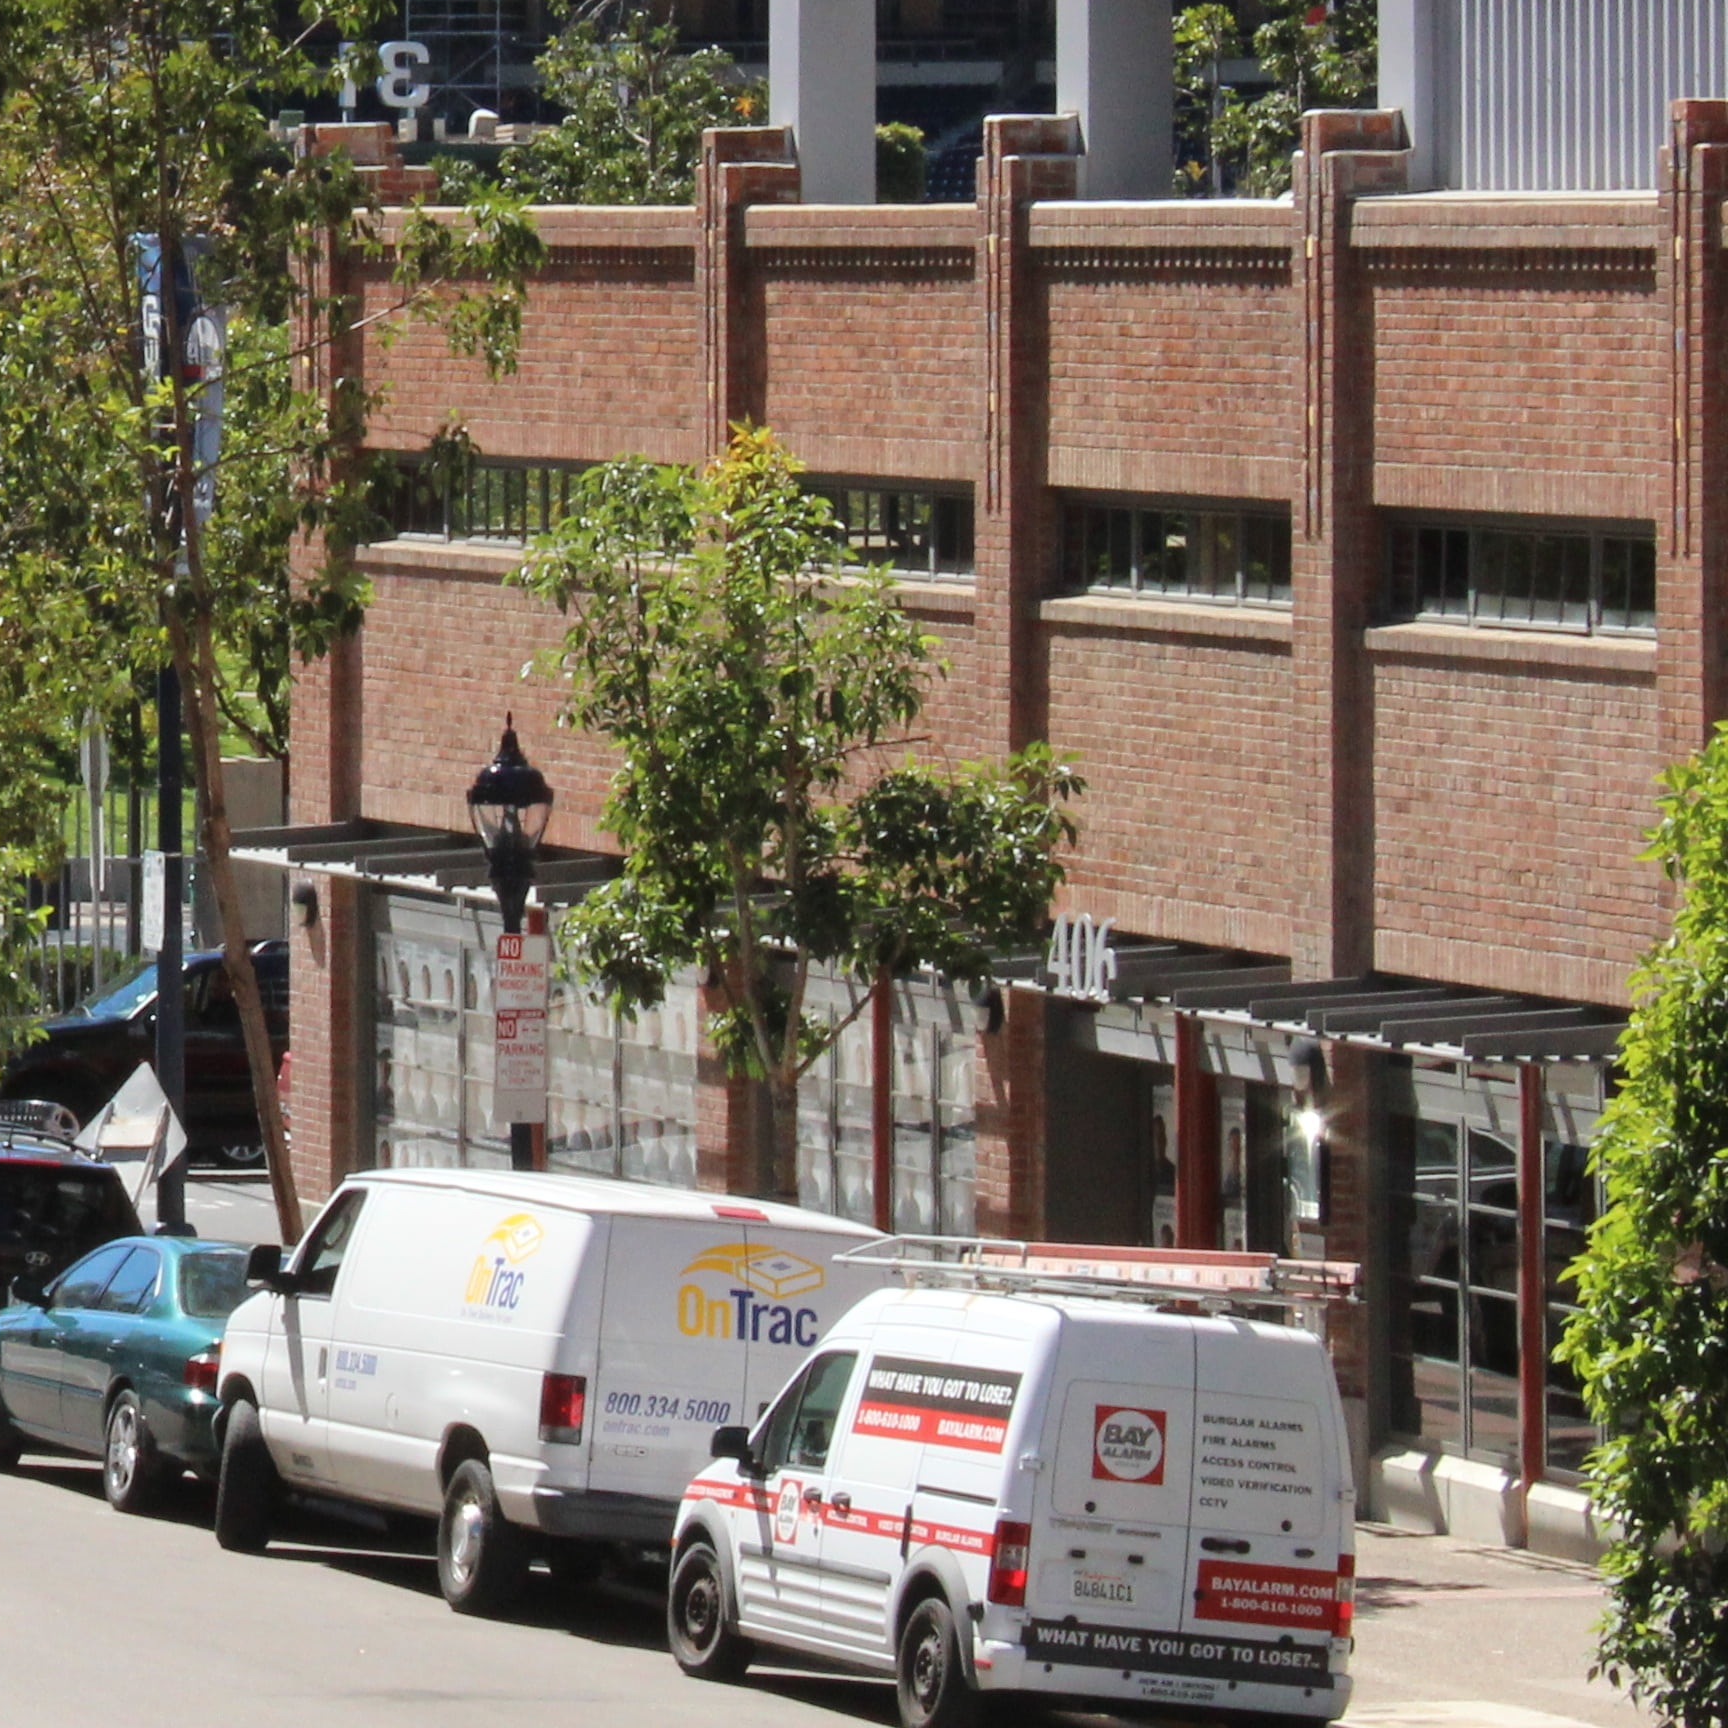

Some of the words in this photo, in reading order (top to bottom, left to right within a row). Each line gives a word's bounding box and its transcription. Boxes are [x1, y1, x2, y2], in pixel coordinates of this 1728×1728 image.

[499, 937, 520, 958] NO
[1047, 912, 1118, 1004] 406
[499, 962, 544, 978] PARKING
[497, 1019, 515, 1038] NO
[497, 1042, 544, 1056] PARKING
[465, 1254, 524, 1309] OnTrac
[677, 1284, 818, 1347] OnTrac
[868, 1370, 896, 1389] WHAT
[895, 1372, 923, 1393] HAVE
[922, 1376, 945, 1396] YOU
[943, 1379, 966, 1400] GOT
[965, 1381, 980, 1402] TO
[604, 1392, 731, 1424] 800.334.5000
[858, 1410, 921, 1432] 1-800-610-1000
[936, 1419, 1005, 1444] BAYALARM.COM
[1202, 1415, 1255, 1428] BURGLAR
[1258, 1419, 1304, 1432] ALARMS
[1103, 1423, 1155, 1448] BAY
[1202, 1435, 1226, 1446] FIRE
[1230, 1438, 1277, 1450] ALARMS
[1102, 1446, 1153, 1461] ALARM
[1201, 1455, 1244, 1468] ACCESS
[1247, 1460, 1296, 1473] CONTROL
[1200, 1476, 1234, 1488] VIDEO
[1237, 1479, 1313, 1495] VERIFICATION
[1199, 1496, 1228, 1509] CCTV
[1074, 1580, 1133, 1602] 84841C1
[1211, 1576, 1333, 1600] BAYALARM.COM
[1221, 1597, 1323, 1616] 1-800-610-1000
[1037, 1627, 1089, 1647] WHAT
[1093, 1633, 1142, 1652] HAVE
[1148, 1638, 1184, 1656] YOU
[1190, 1643, 1226, 1660] GOT
[1231, 1647, 1253, 1663] TO
[1259, 1650, 1313, 1668] LOSE?
